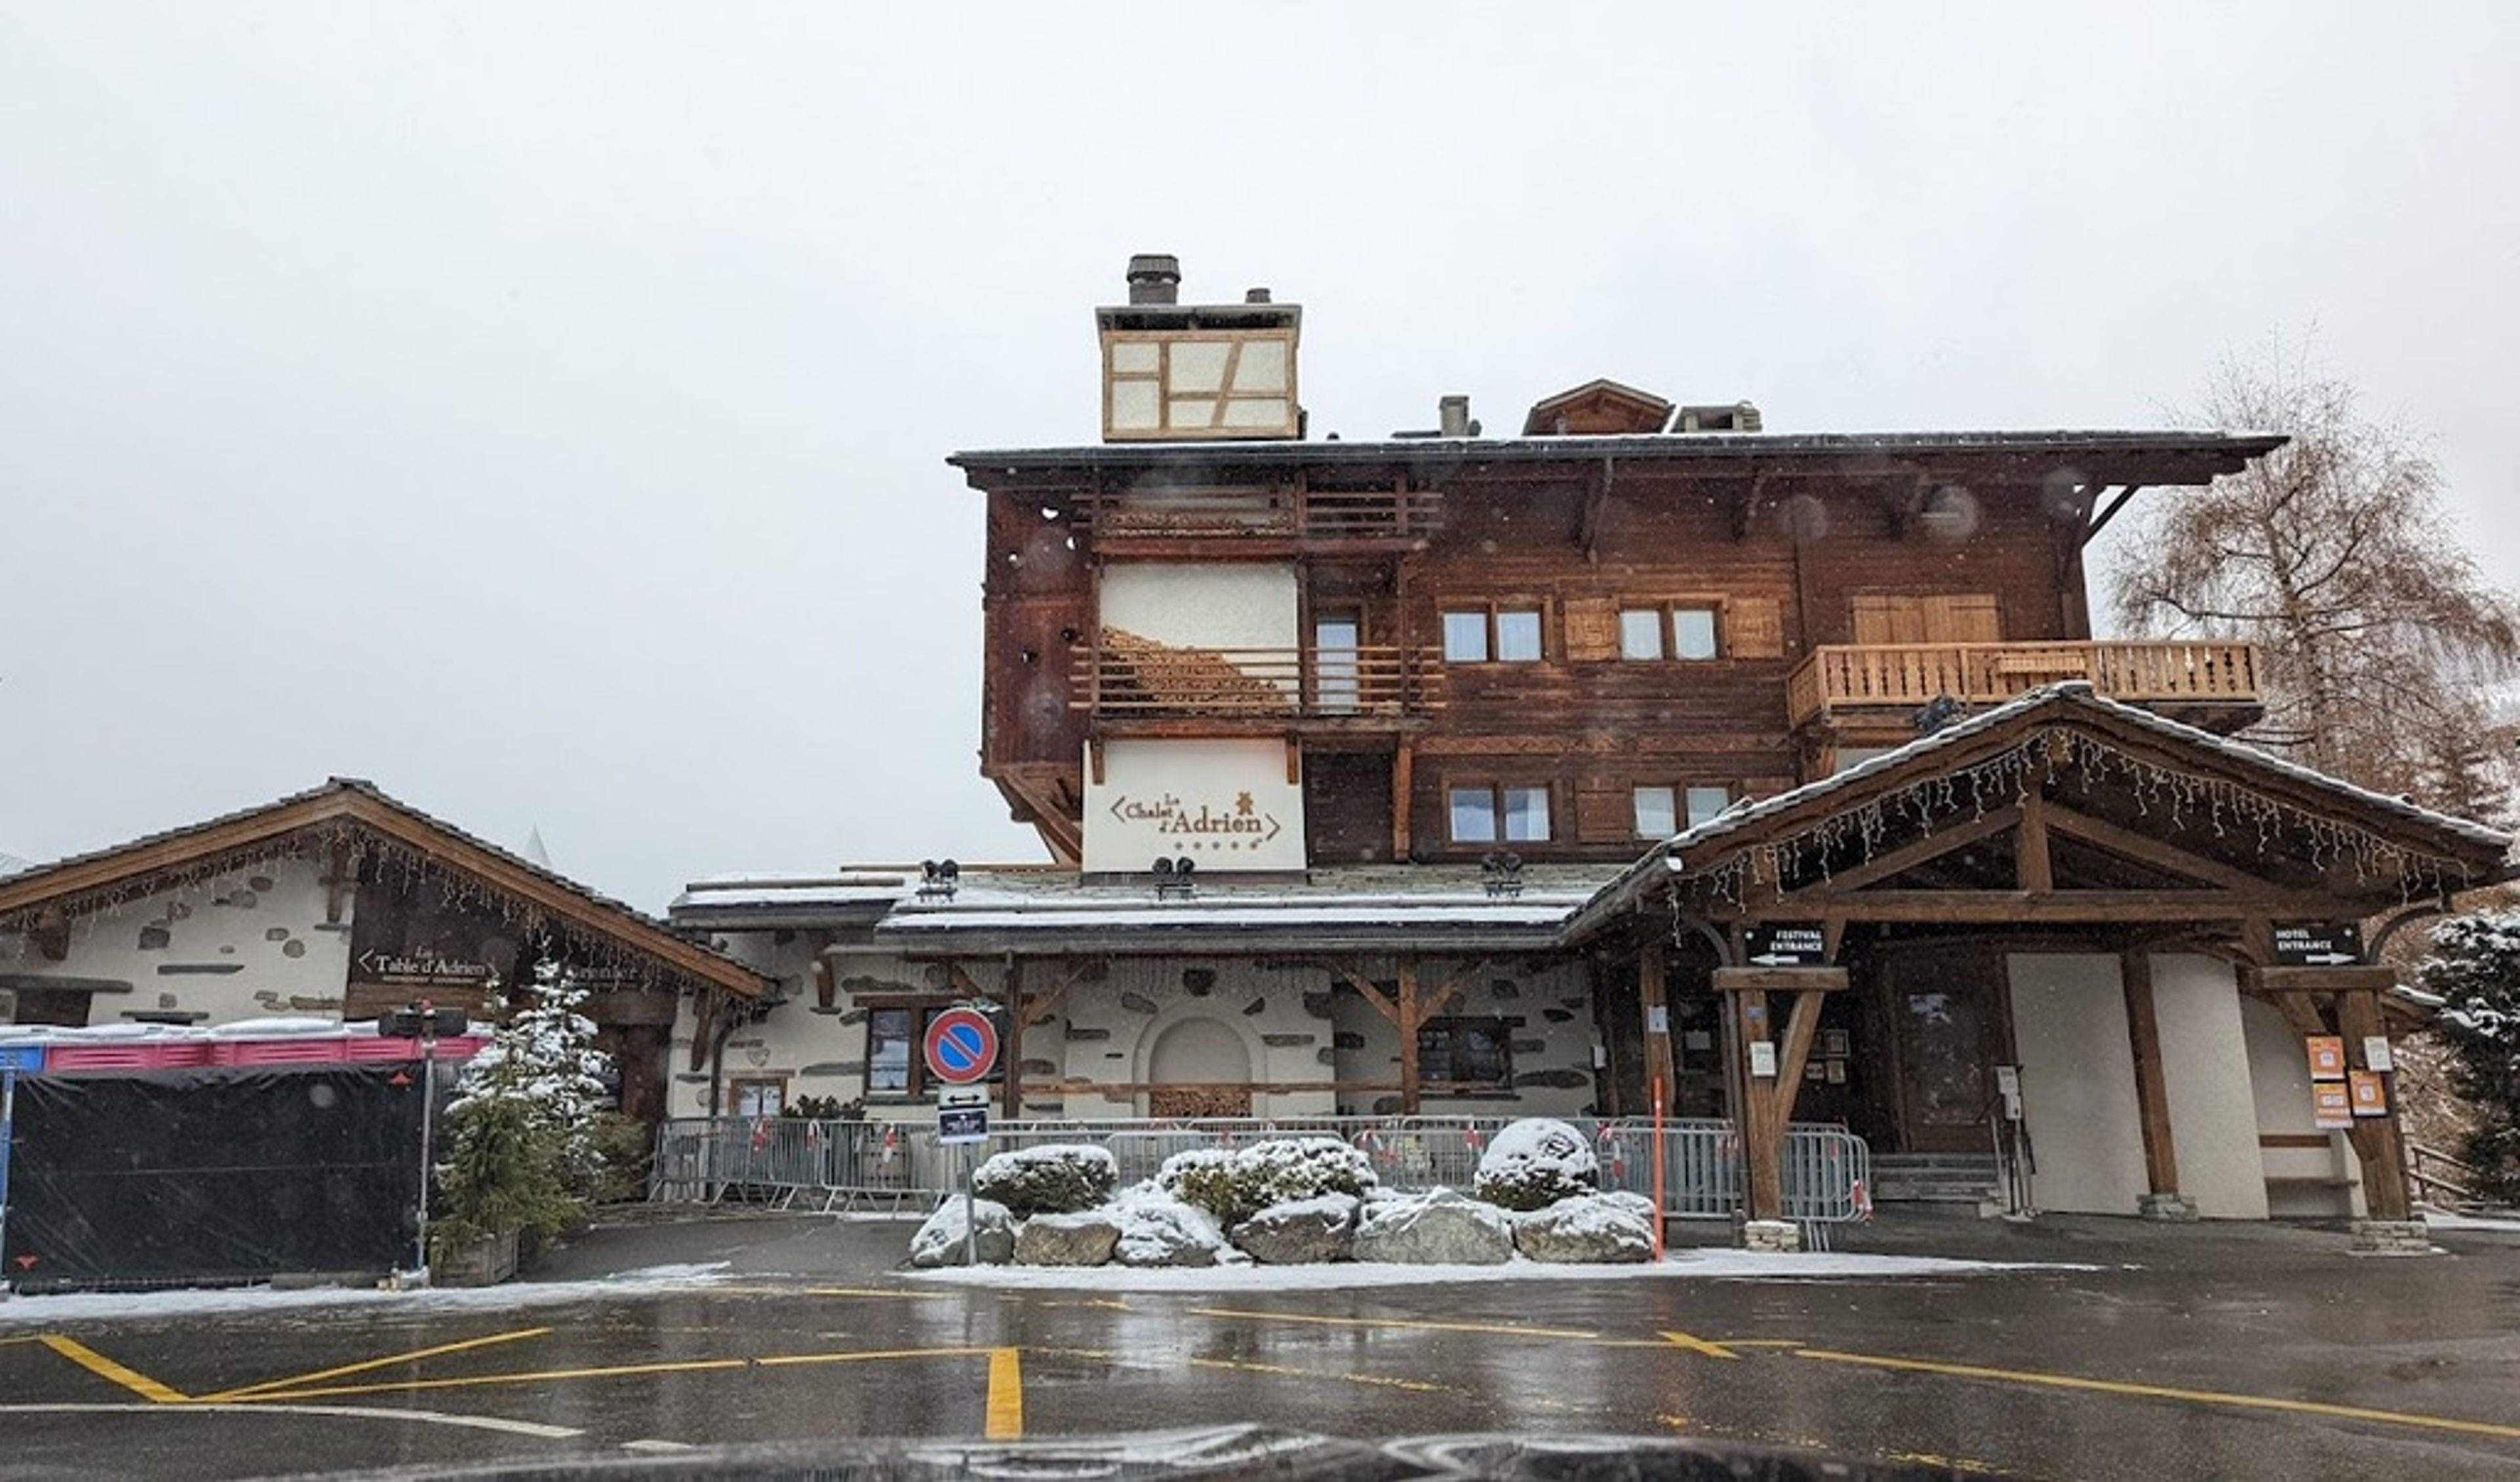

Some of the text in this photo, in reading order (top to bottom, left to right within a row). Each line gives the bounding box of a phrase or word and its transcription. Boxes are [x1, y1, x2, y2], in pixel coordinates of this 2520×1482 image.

[1125, 801, 1173, 818] Chalet
[1776, 930, 1822, 939] FESTIVAL
[2276, 929, 2311, 939] HOTEL
[1770, 941, 1822, 951] ENTRANCE
[2278, 941, 2331, 950] ENTRANCE
[375, 955, 486, 976] Table d'Adrien
